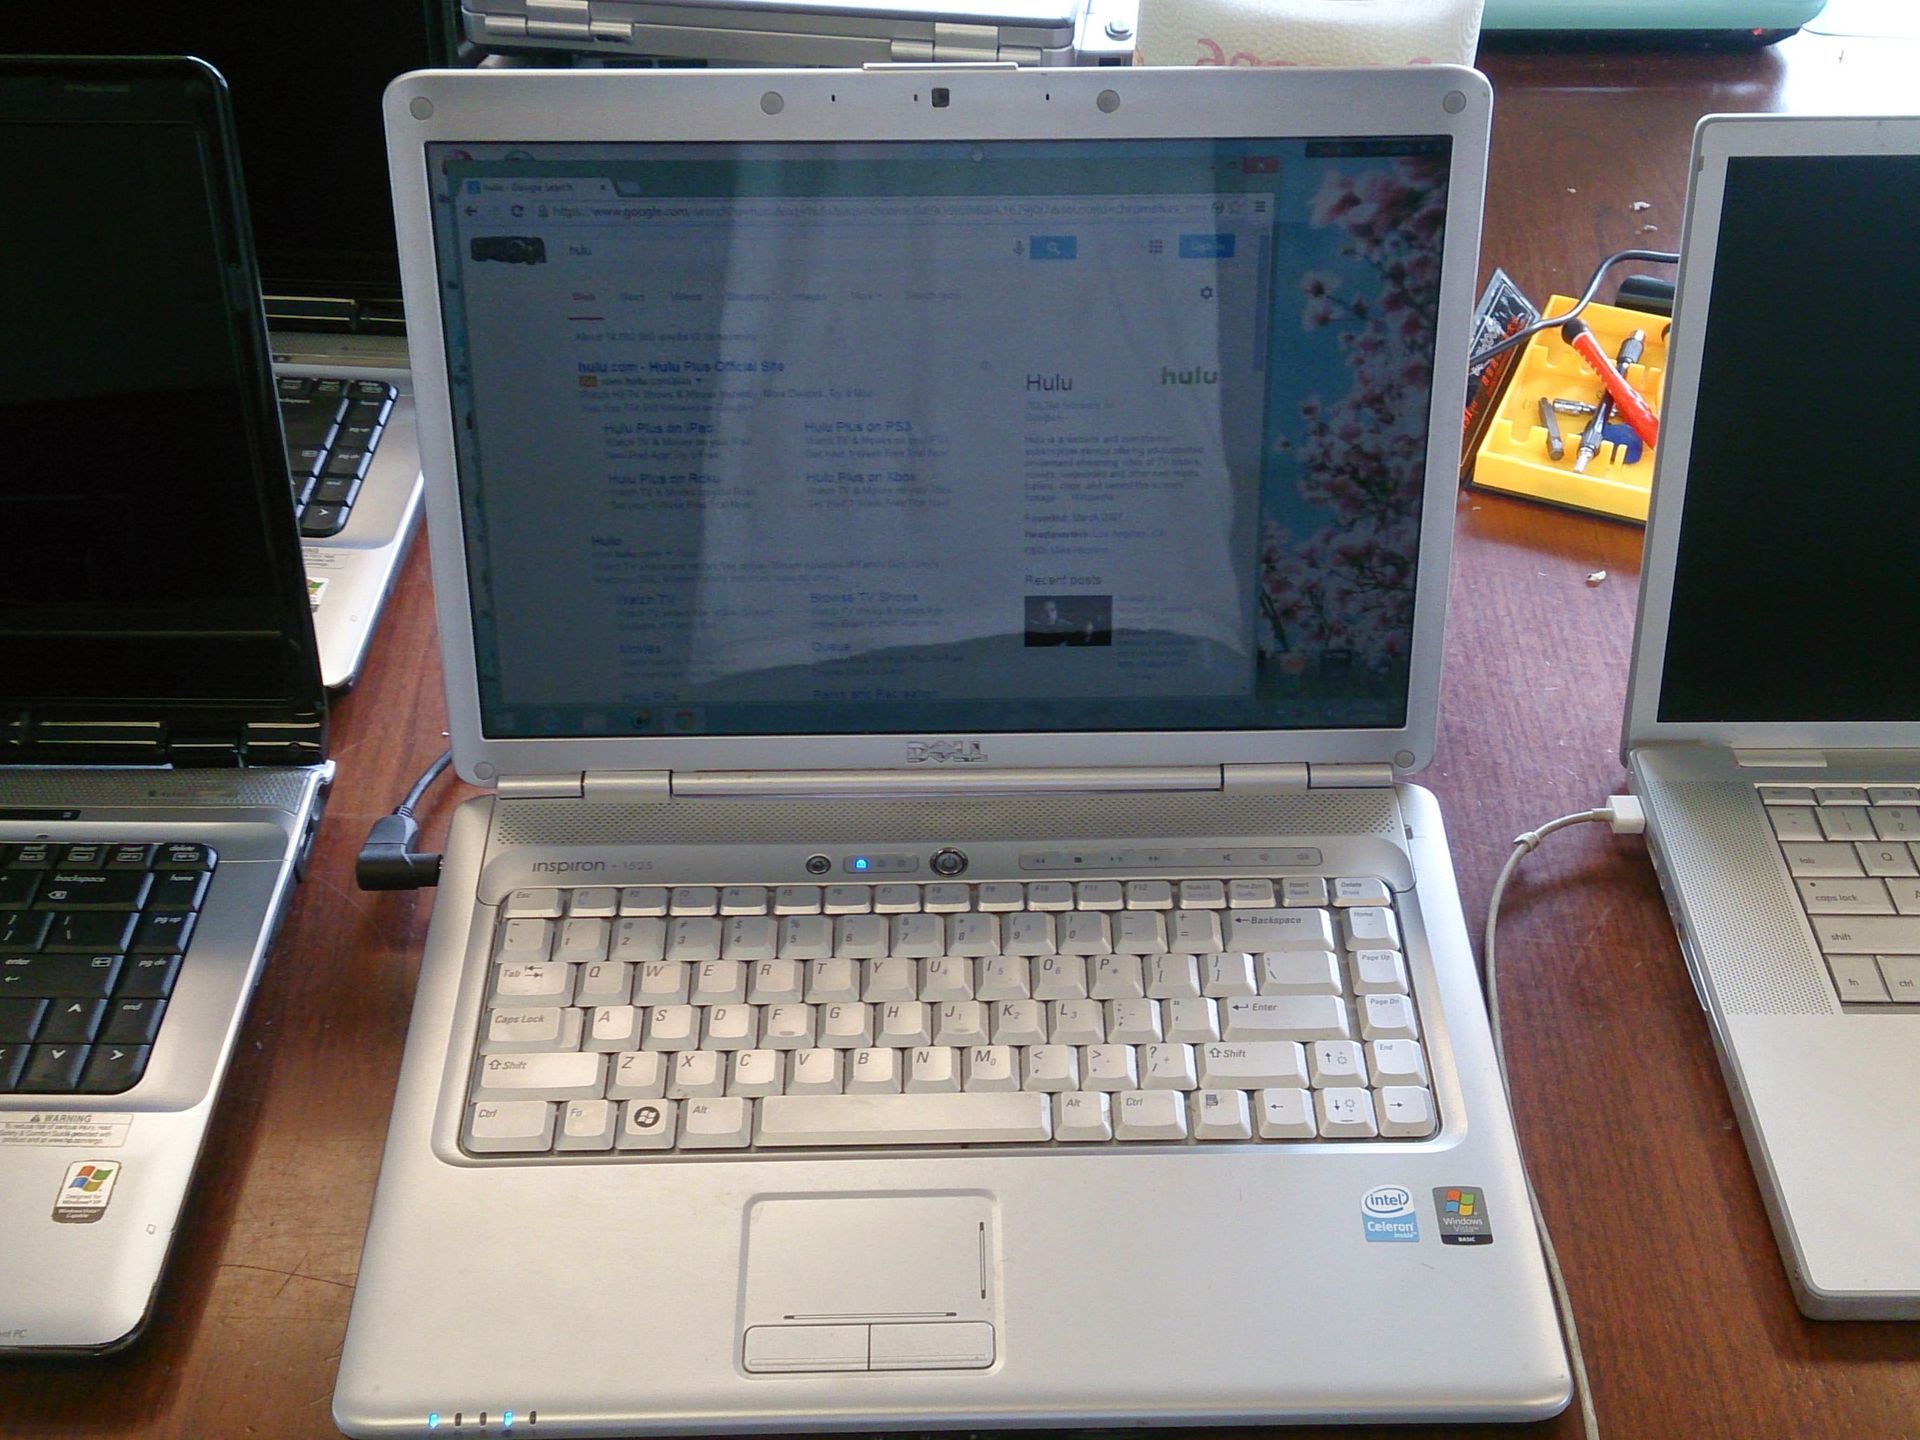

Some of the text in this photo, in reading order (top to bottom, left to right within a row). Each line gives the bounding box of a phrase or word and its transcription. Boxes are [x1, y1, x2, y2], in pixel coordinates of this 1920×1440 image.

[650, 361, 680, 372] Hulu
[684, 361, 711, 372] Plus
[761, 360, 785, 372] Site
[1161, 366, 1218, 385] hulu
[1026, 374, 1072, 391] Hulu
[637, 423, 663, 434] Plus
[836, 421, 863, 432] Plus
[1025, 575, 1102, 587] Recent posts
[906, 740, 988, 763] DELL
[1897, 822, 1906, 832] 2
[1881, 852, 1894, 862] Q
[532, 859, 606, 875] inspiron
[54, 874, 106, 883] backspace
[1251, 916, 1301, 926] Backspace
[677, 936, 686, 945] 3
[734, 935, 742, 944] 4
[790, 934, 797, 943] 5
[846, 934, 853, 942] 6
[902, 933, 909, 942] 7
[958, 932, 966, 941] 8
[1013, 931, 1021, 940] 9
[1068, 930, 1076, 940] 0
[1831, 933, 1852, 941] shift
[621, 937, 630, 946] 2
[760, 964, 772, 976] R
[817, 963, 828, 975] T
[873, 961, 883, 973] Y
[929, 960, 941, 973] U
[1043, 958, 1054, 971] O
[1099, 958, 1110, 970] P
[503, 968, 521, 978] Tab
[588, 965, 601, 978] Q
[646, 965, 663, 977] W
[704, 965, 714, 977] E
[829, 1006, 841, 1020] G
[887, 1005, 900, 1018] H
[945, 1005, 955, 1018] J
[1002, 1004, 1015, 1016] K
[1060, 1003, 1069, 1015] L
[1252, 1002, 1278, 1012] Enter
[494, 1013, 544, 1025] Caps Lock
[598, 1010, 611, 1023] A
[655, 1009, 668, 1022] S
[714, 1008, 727, 1021] D
[772, 1008, 783, 1020] F
[799, 1053, 810, 1066] V
[858, 1052, 870, 1065] B
[916, 1051, 930, 1064] N
[975, 1050, 991, 1063] M
[1223, 1049, 1247, 1058] Shift
[502, 1060, 527, 1070] Shift
[621, 1056, 635, 1069] Z
[681, 1055, 695, 1068] X
[739, 1053, 751, 1067] C
[1066, 1098, 1081, 1107] Alt
[1126, 1097, 1144, 1107] Ctrl
[478, 1108, 497, 1118] Ctrl
[692, 1105, 708, 1114] Alt
[44, 1114, 92, 1123] WARNING
[1370, 1193, 1402, 1207] intel
[1367, 1221, 1414, 1232] Celeron
[1443, 1217, 1483, 1226] Windows
